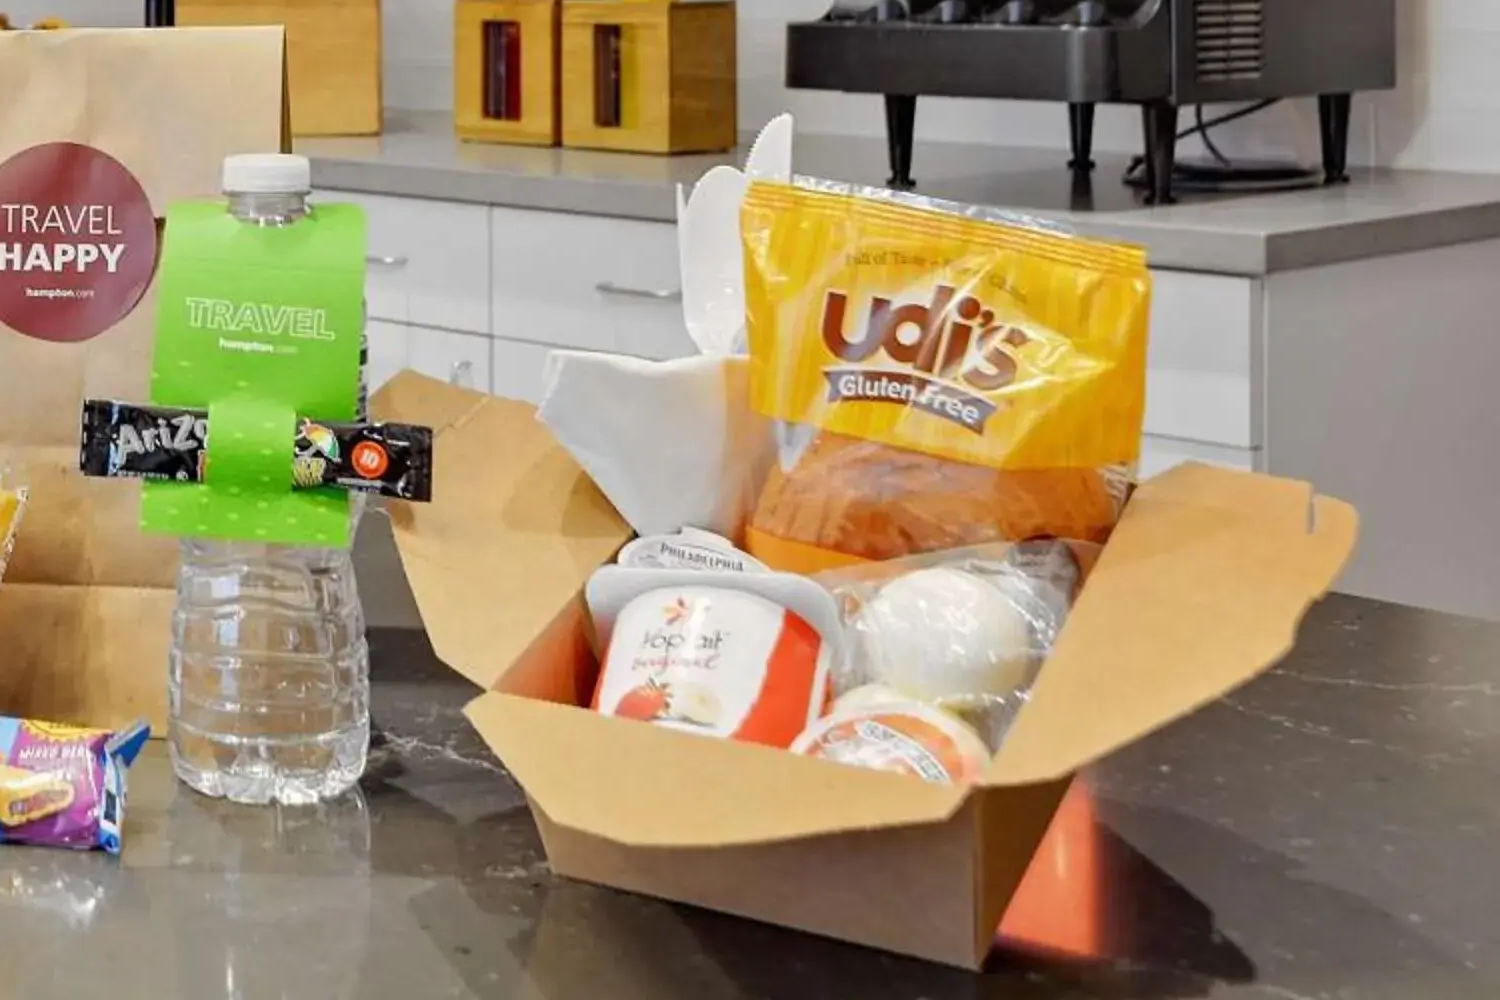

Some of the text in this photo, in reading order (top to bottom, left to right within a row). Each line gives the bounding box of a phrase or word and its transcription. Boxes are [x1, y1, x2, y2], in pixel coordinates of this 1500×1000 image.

[1, 204, 122, 235] TRAVEL
[26, 287, 95, 300] hampton.com
[185, 296, 336, 342] TRAVEL
[838, 375, 980, 424] Gluten Free
[659, 542, 745, 572] PHILADELPHIA
